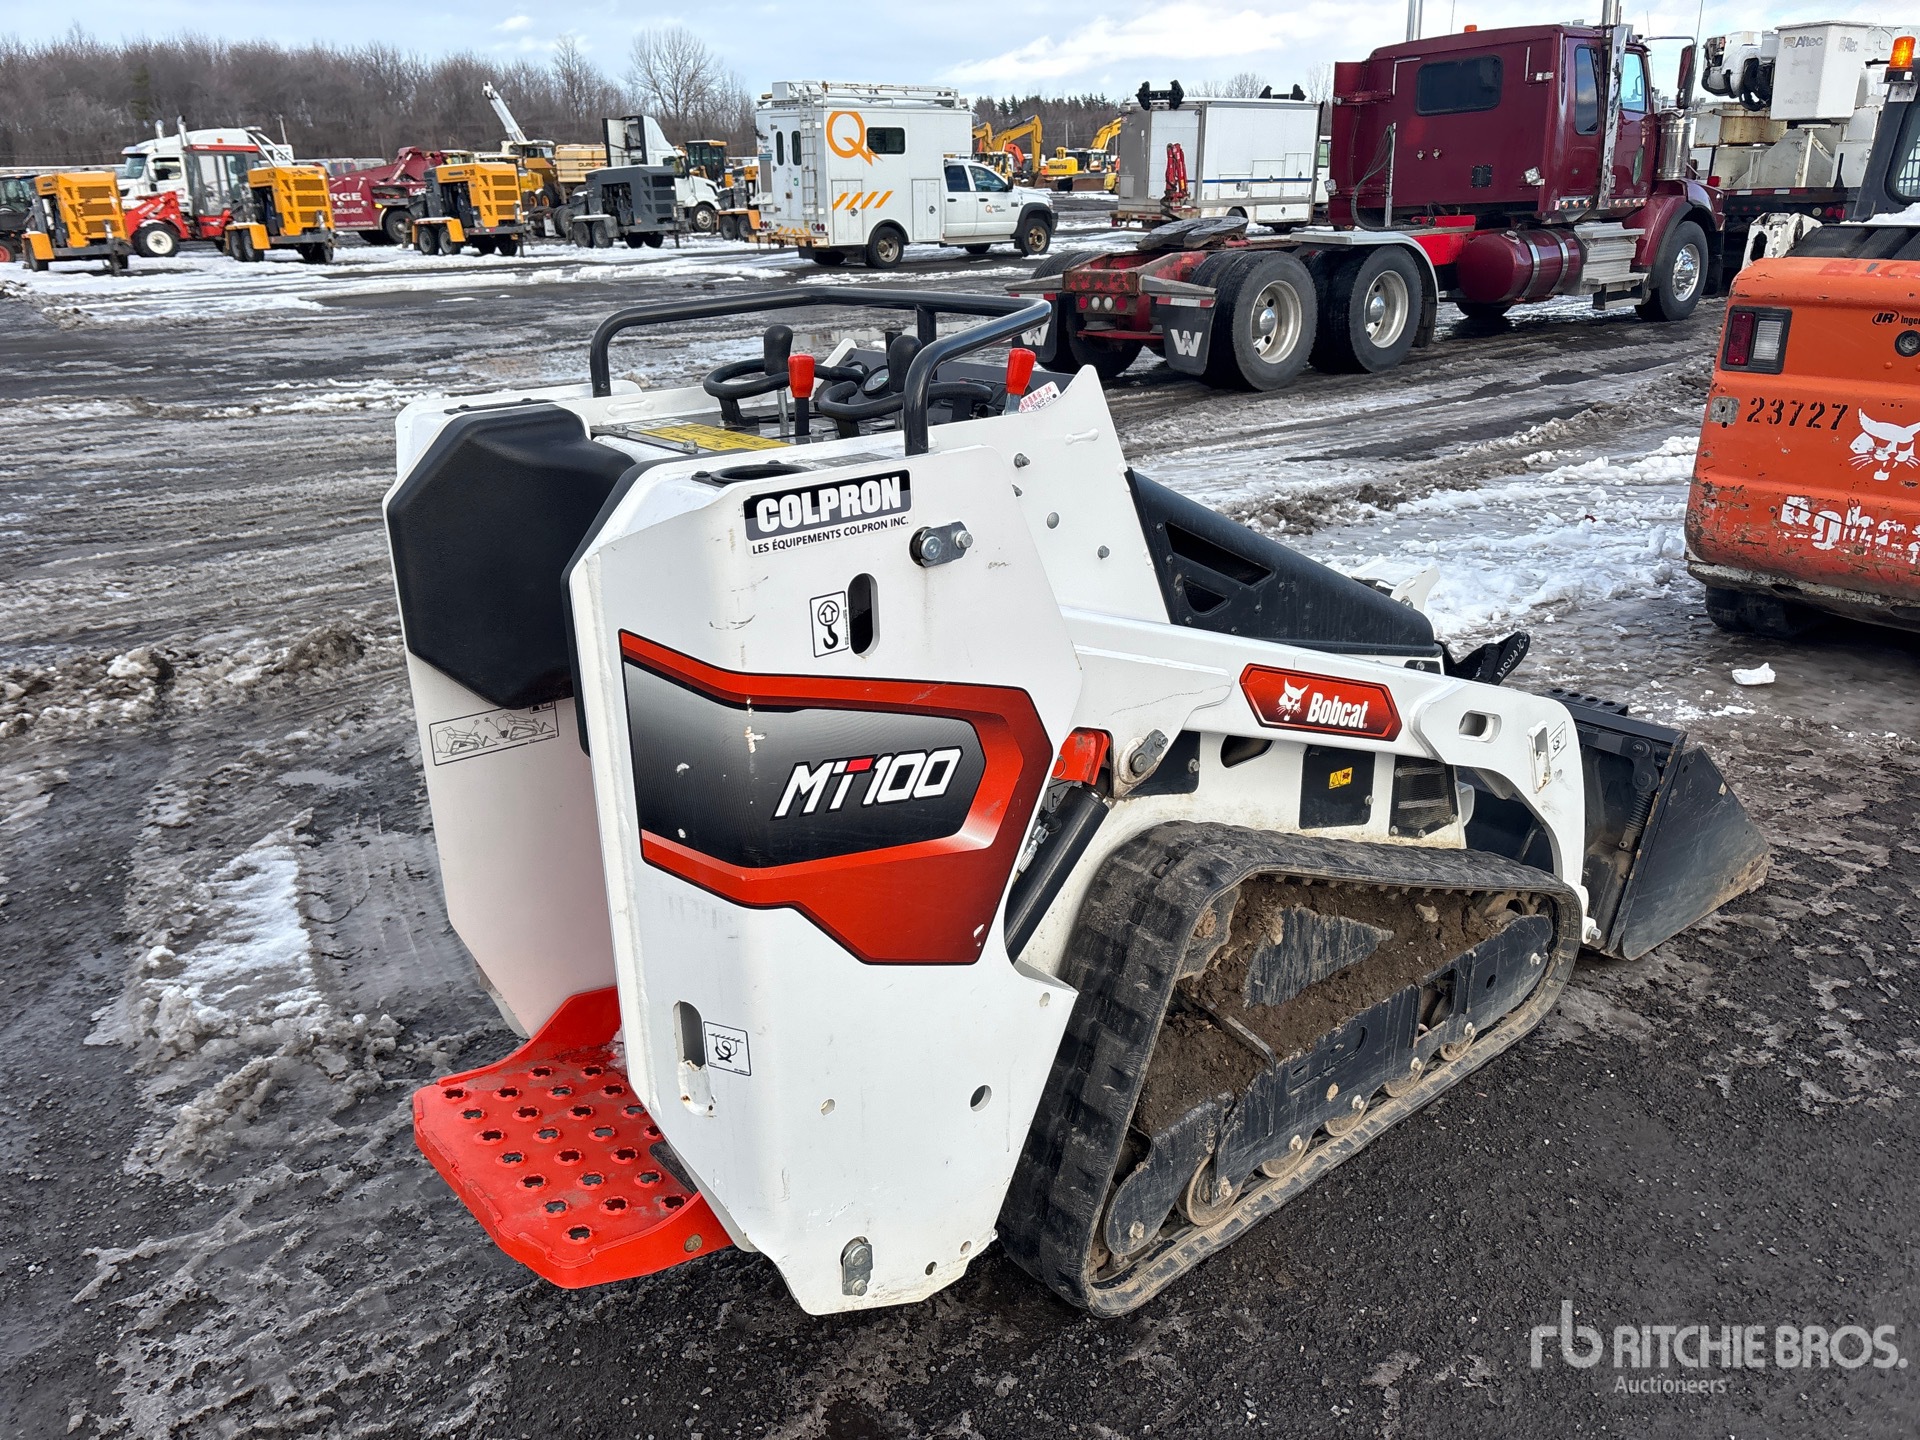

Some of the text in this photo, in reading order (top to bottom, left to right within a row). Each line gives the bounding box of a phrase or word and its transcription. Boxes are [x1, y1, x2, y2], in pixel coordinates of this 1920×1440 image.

[1795, 36, 1823, 48] Altec
[1874, 311, 1897, 324] IR
[1747, 396, 1849, 431] 23727
[756, 476, 901, 533] COLPRON
[752, 516, 909, 555] LES ÉQUIPEMENTS COLPRON INC.
[1307, 692, 1369, 728] Bobcat
[772, 746, 963, 819] MT100
